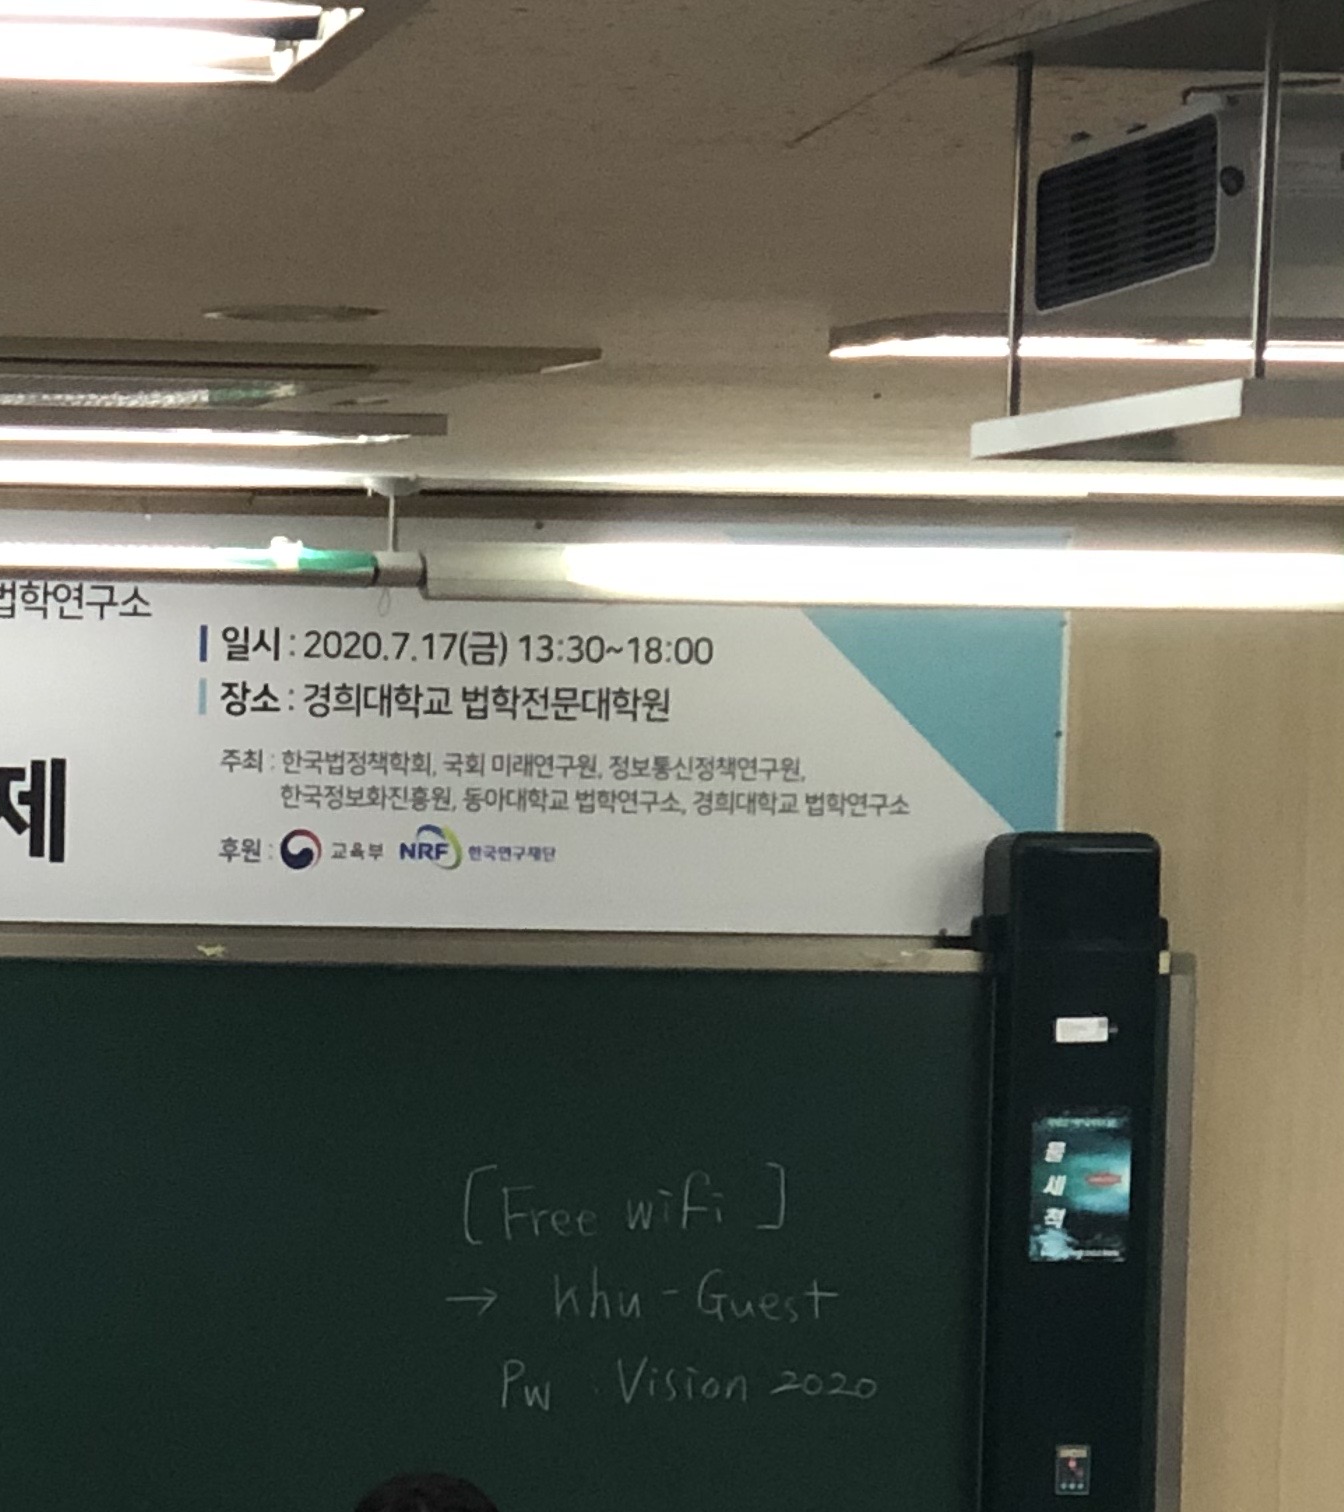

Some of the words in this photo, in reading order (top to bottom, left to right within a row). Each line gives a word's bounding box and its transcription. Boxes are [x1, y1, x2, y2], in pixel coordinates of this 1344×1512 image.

[303, 629, 509, 669] 2020.7.17(금)
[518, 633, 715, 667] 13:30~18:00
[303, 682, 453, 720] 경희대학교
[461, 685, 671, 724] 법학전문대학원
[443, 751, 486, 777] 국회
[463, 785, 570, 814] 동아대학교
[692, 790, 800, 817] 경희대학교
[804, 791, 911, 818] 법학연구소
[330, 841, 385, 861] 교육부
[398, 841, 449, 861] NRF
[467, 843, 557, 863] 한국연구재단
